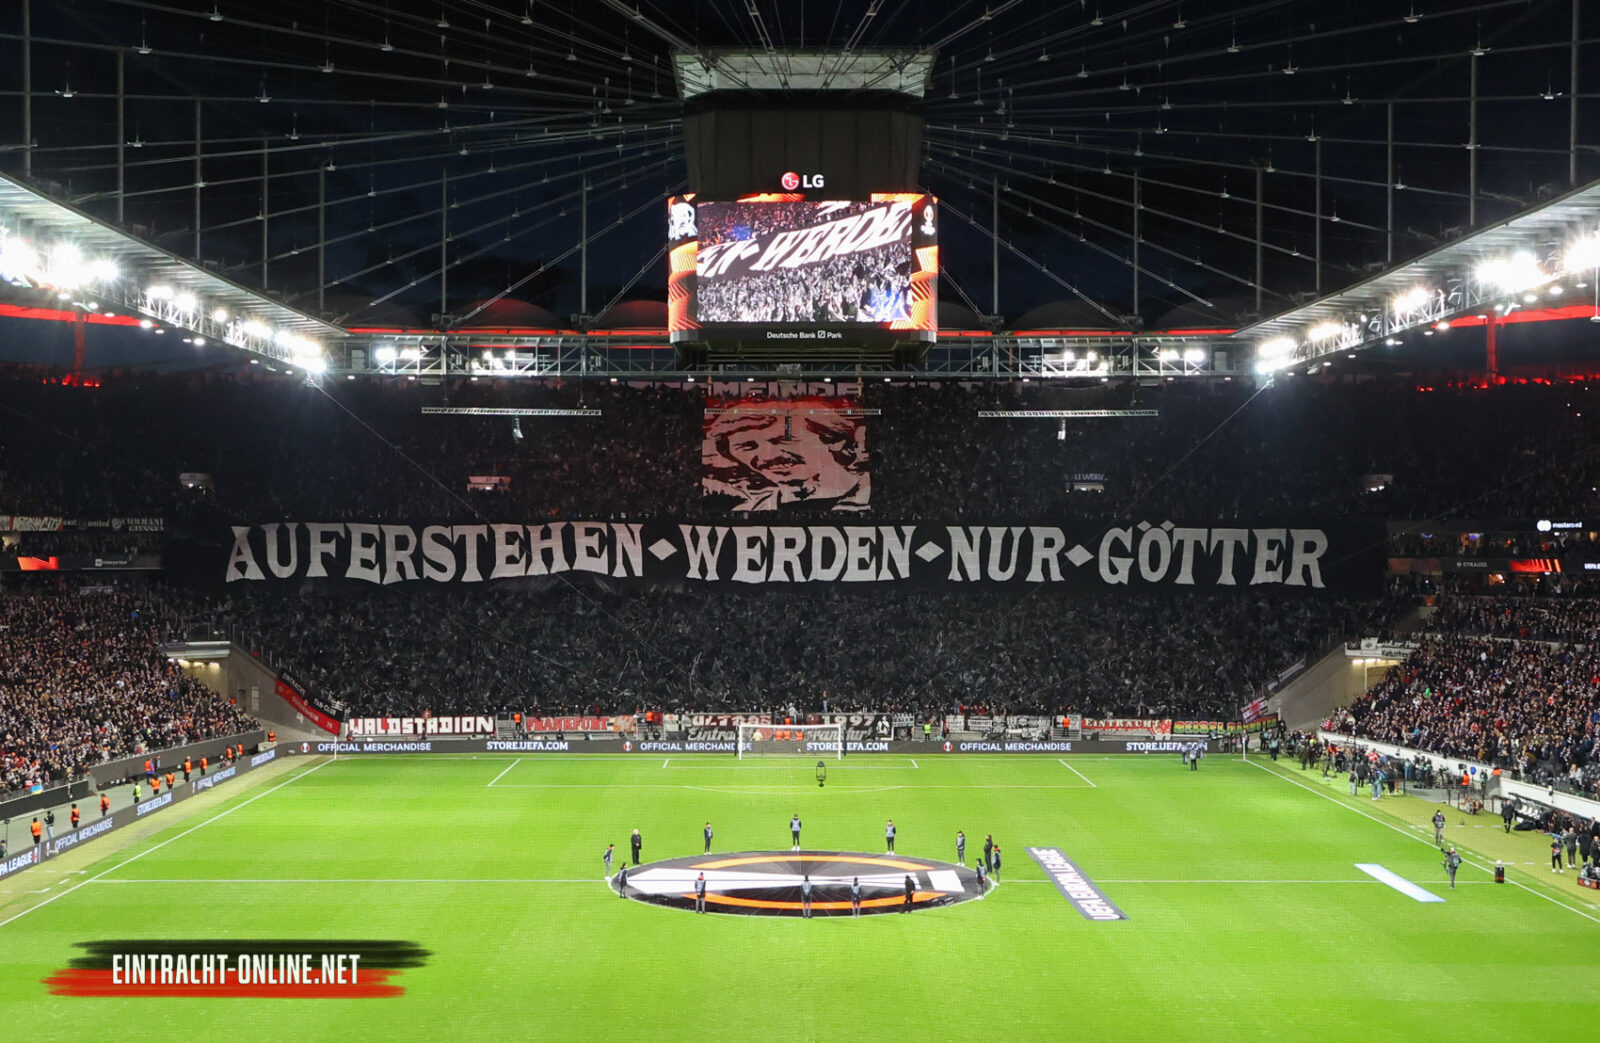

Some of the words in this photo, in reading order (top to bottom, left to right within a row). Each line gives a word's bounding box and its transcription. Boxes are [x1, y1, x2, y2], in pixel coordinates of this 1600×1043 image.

[802, 174, 825, 188] LG
[766, 331, 798, 339] Deutsche
[799, 331, 816, 339] Bank
[827, 331, 842, 339] Park
[226, 522, 644, 585] AUFERSTEHEN
[678, 524, 916, 584] WERDEN
[946, 526, 1066, 582] NUR
[1099, 519, 1329, 588] GÖTTER
[349, 716, 494, 734] WALDSTADION
[525, 716, 609, 731] FRANKFURT
[317, 743, 361, 752] OFFICIAL
[364, 742, 432, 752] MERCHANDISE
[486, 741, 569, 751] STORE.UEFA.COM
[640, 743, 681, 751] OFFICIAL
[960, 743, 1002, 751] OFFICIAL
[1005, 743, 1072, 751] MERCHANDISE
[54, 832, 78, 849] OFFICIAL
[79, 817, 113, 840] MERCHANDISE
[9, 851, 33, 871] LEAGUE
